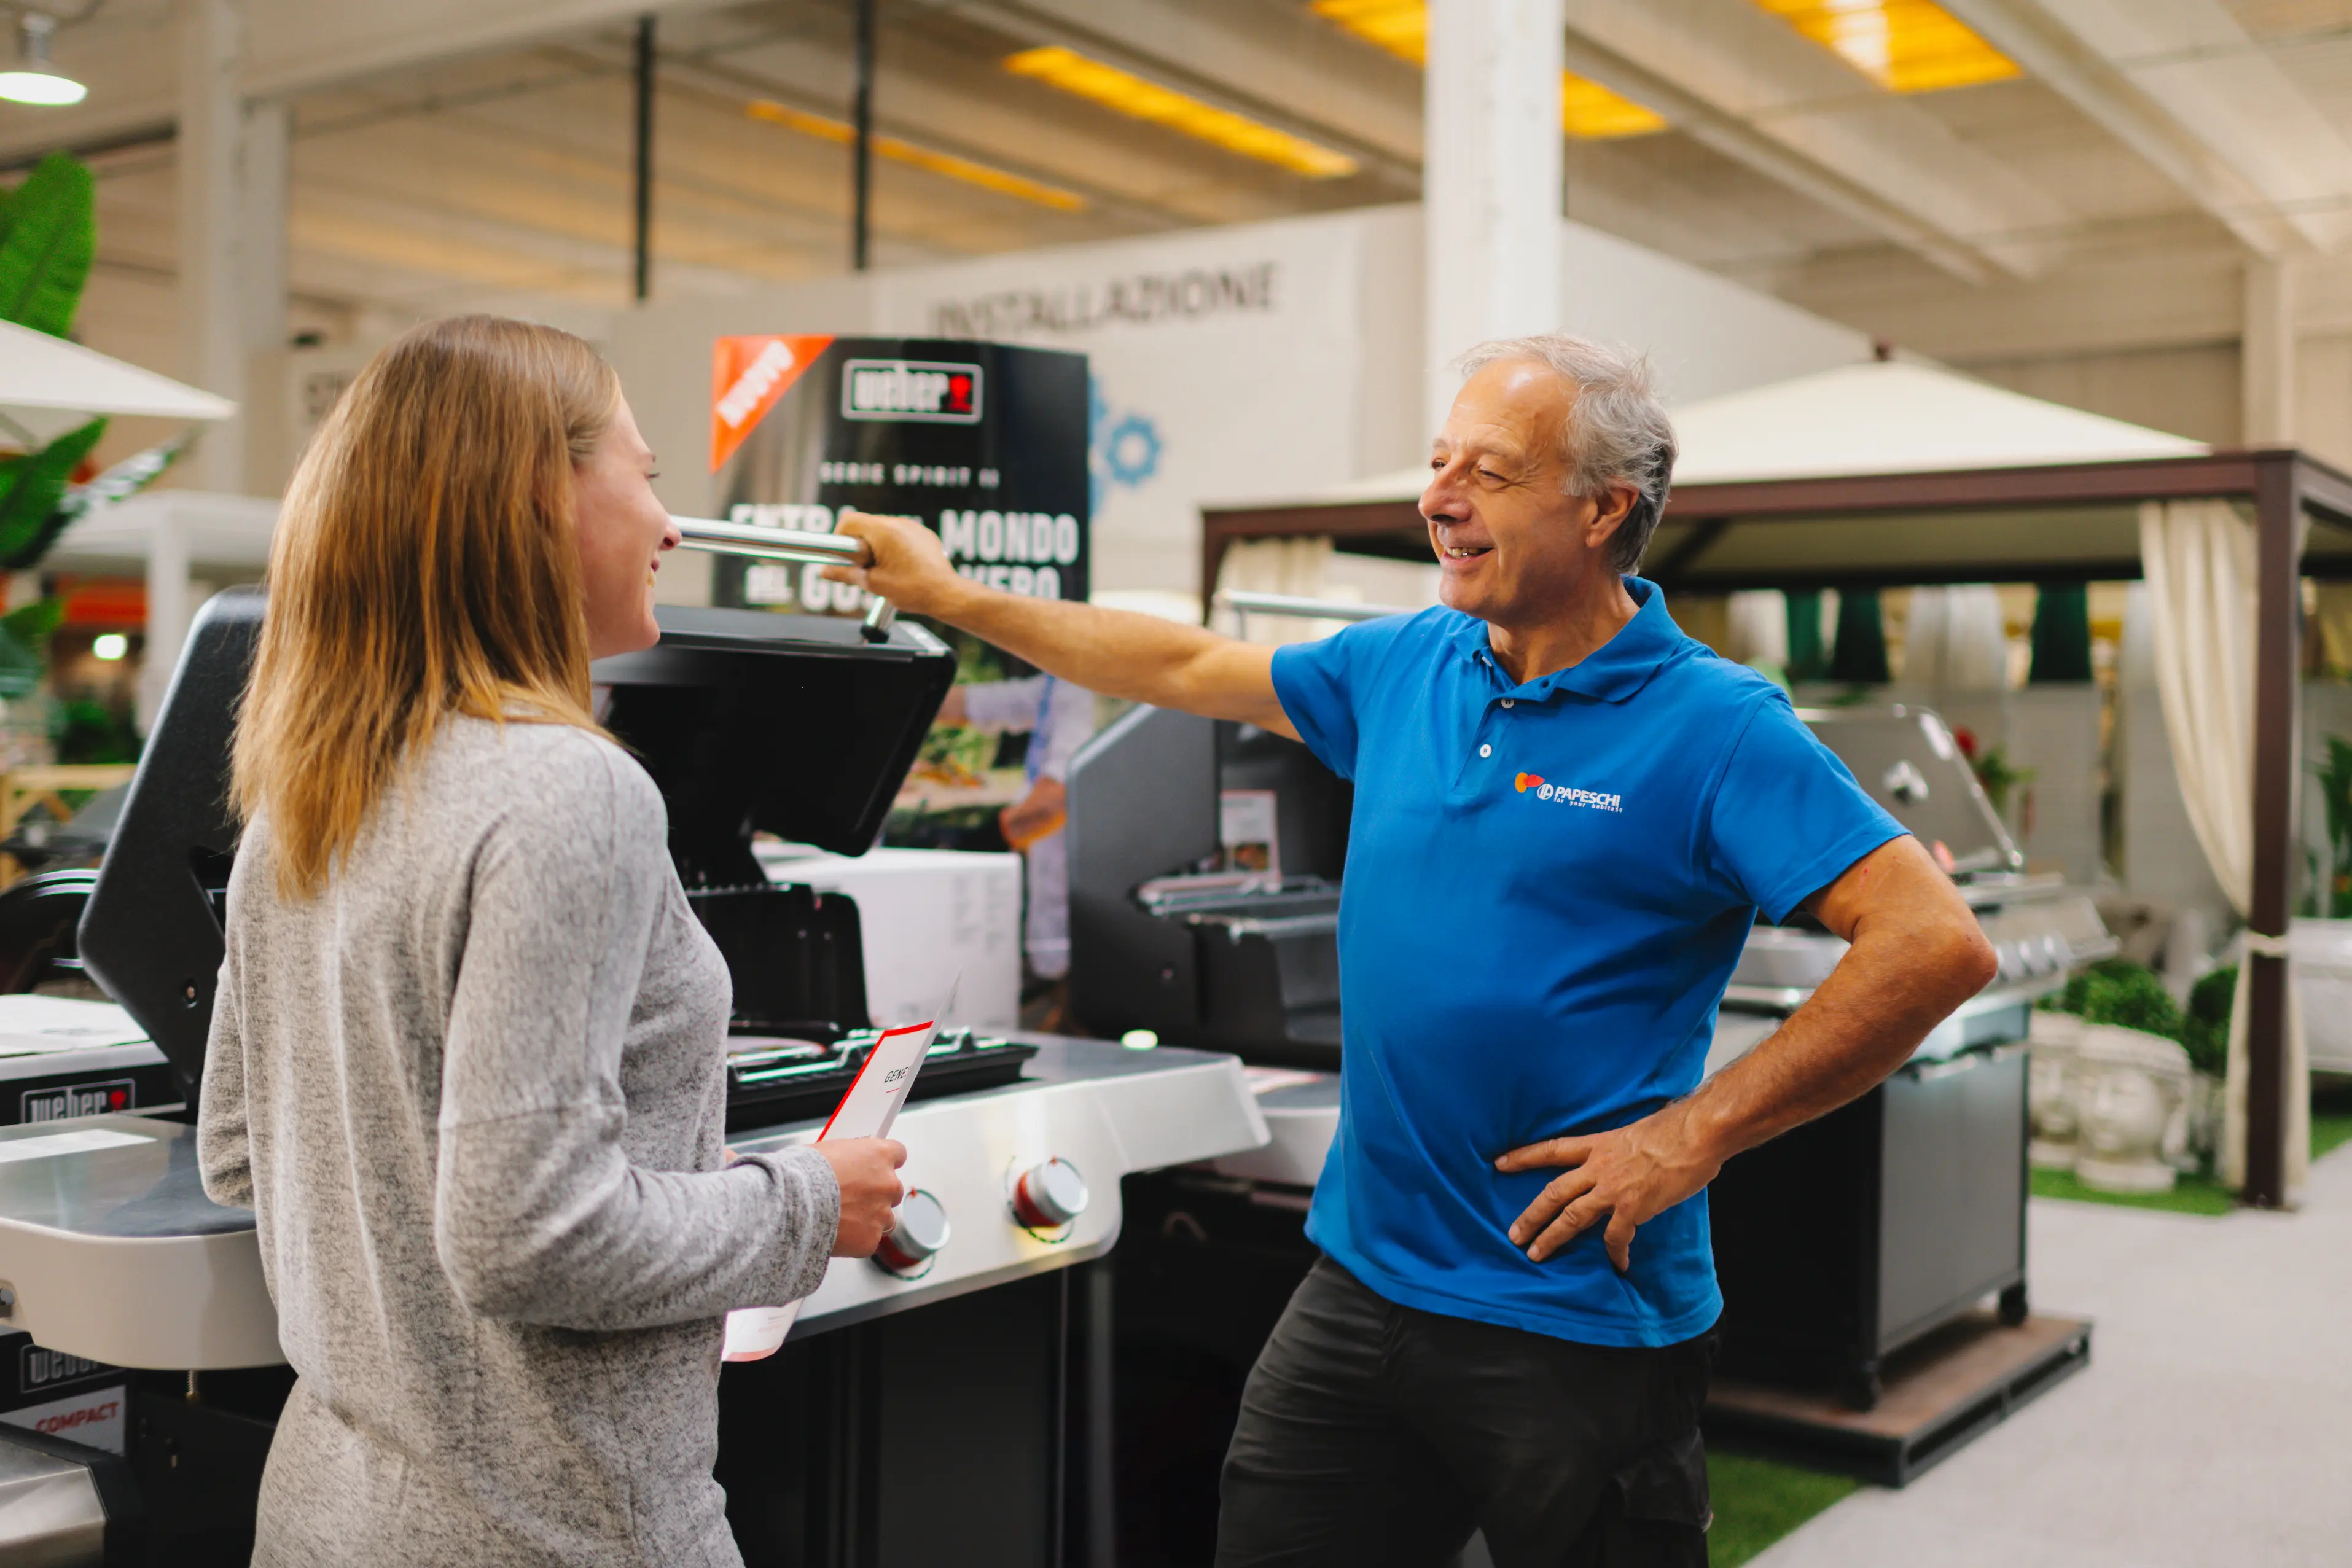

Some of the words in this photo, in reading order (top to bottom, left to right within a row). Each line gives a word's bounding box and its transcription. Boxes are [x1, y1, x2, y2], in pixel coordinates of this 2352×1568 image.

[940, 509, 1079, 565] MONDO
[1555, 786, 1621, 807] PAPESCHI
[884, 1066, 912, 1083] GENE
[35, 1401, 120, 1434] COMPACT
